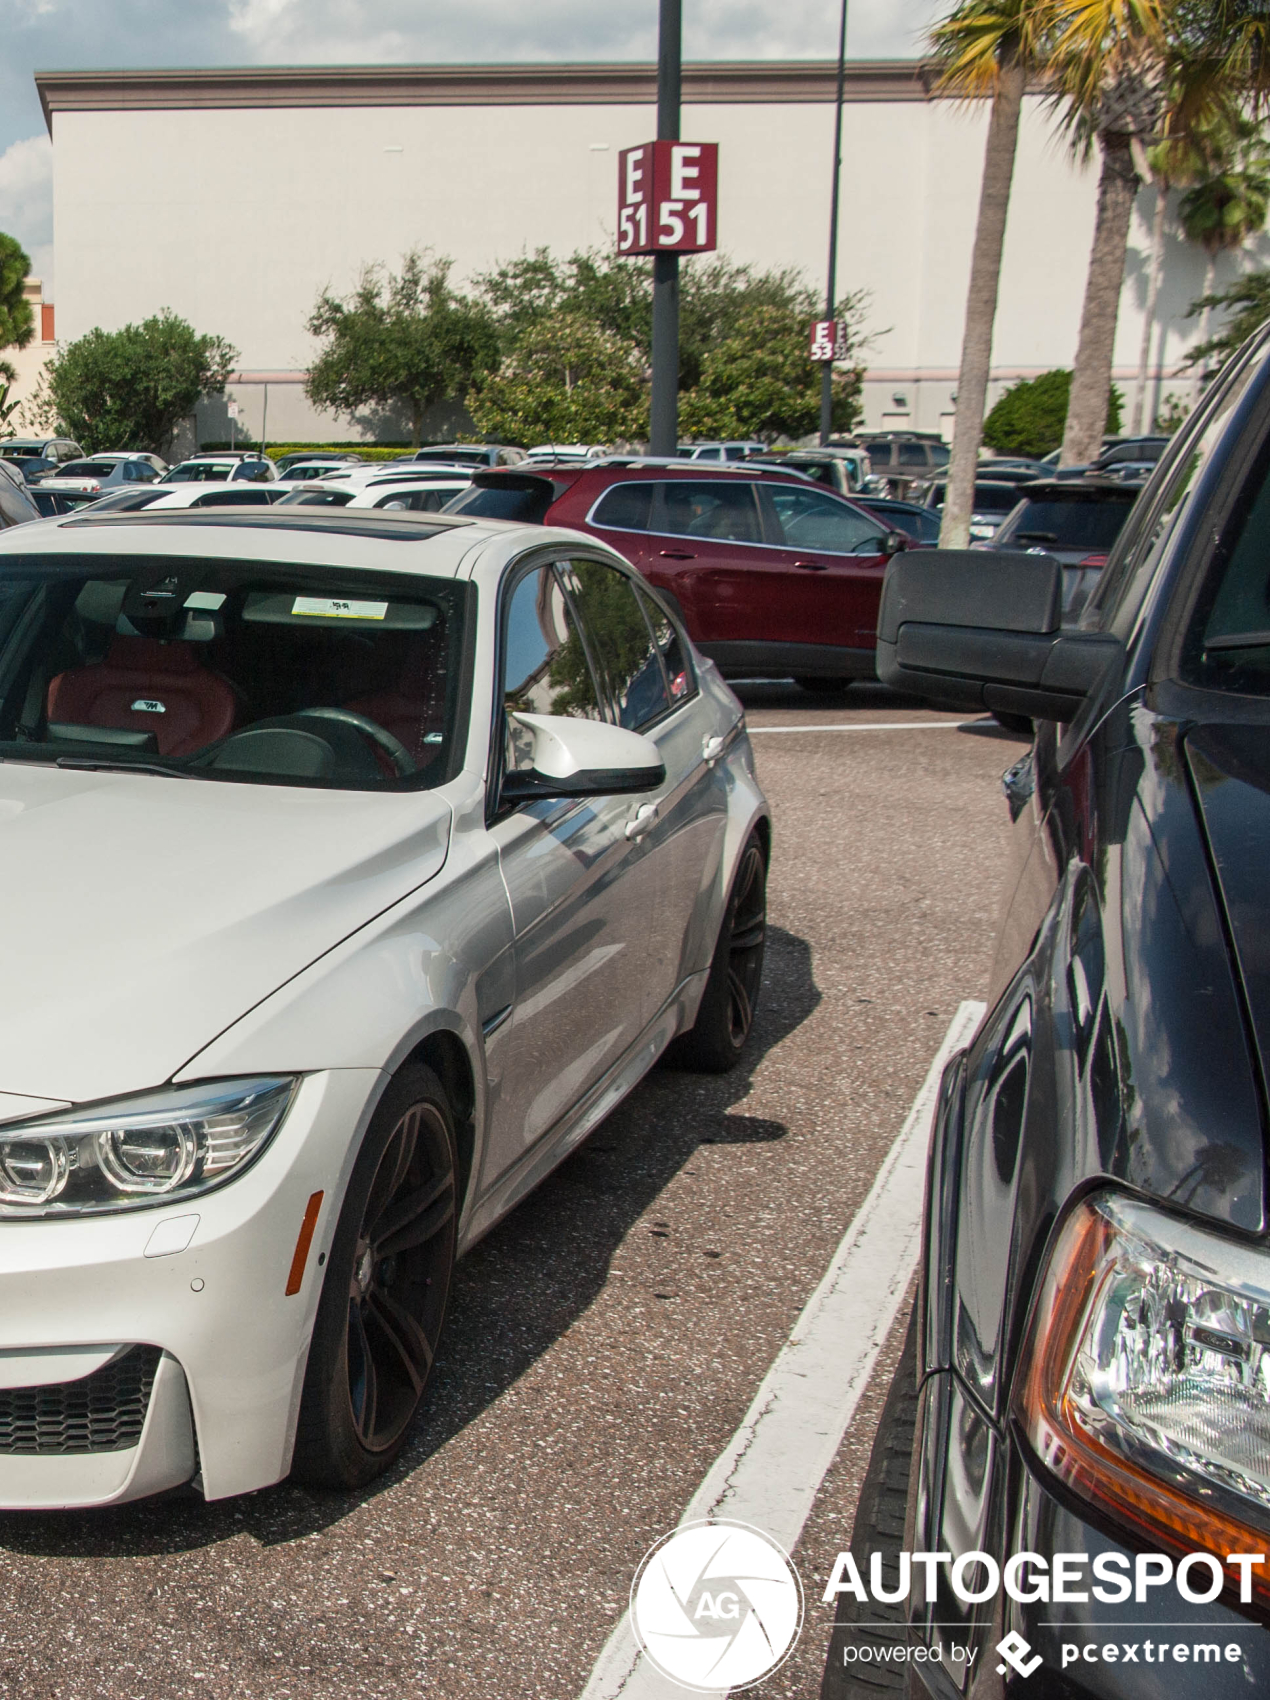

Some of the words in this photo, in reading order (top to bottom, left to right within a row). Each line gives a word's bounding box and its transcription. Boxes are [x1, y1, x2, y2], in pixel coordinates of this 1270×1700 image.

[626, 148, 644, 205] E
[671, 146, 701, 200] E
[619, 203, 647, 250] 51
[658, 201, 708, 246] 51
[810, 342, 833, 360] 53
[815, 322, 830, 343] E
